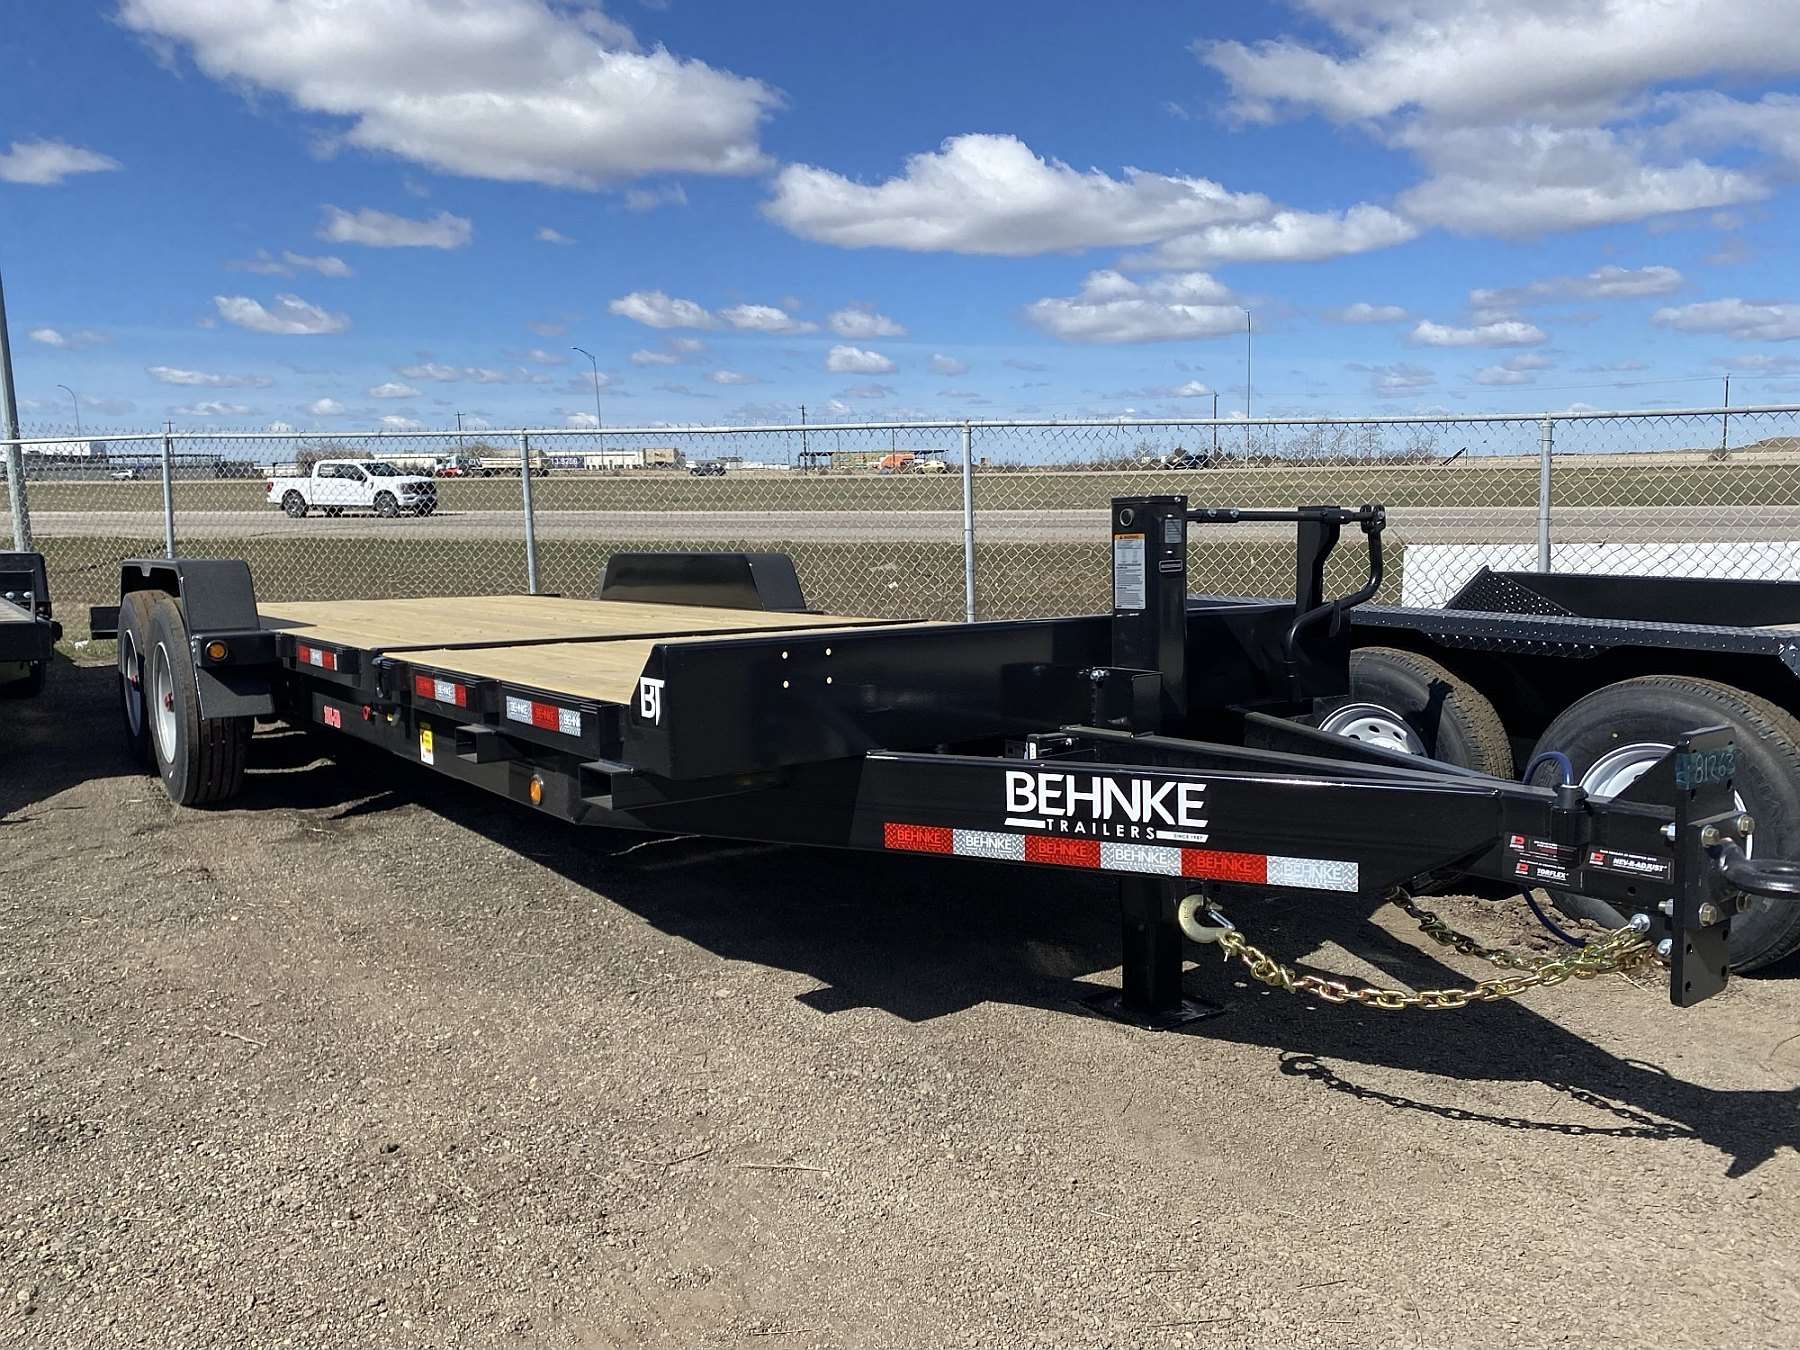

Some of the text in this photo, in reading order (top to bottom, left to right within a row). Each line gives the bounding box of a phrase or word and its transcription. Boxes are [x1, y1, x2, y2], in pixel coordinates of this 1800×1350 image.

[640, 676, 665, 727] BT
[1005, 770, 1209, 828] BEHNKE
[897, 829, 1342, 880] BEHNKE BEHNKE BEHNKE BEHNKE BEHNKE BEHNKE
[1046, 818, 1156, 840] TRAILERS
